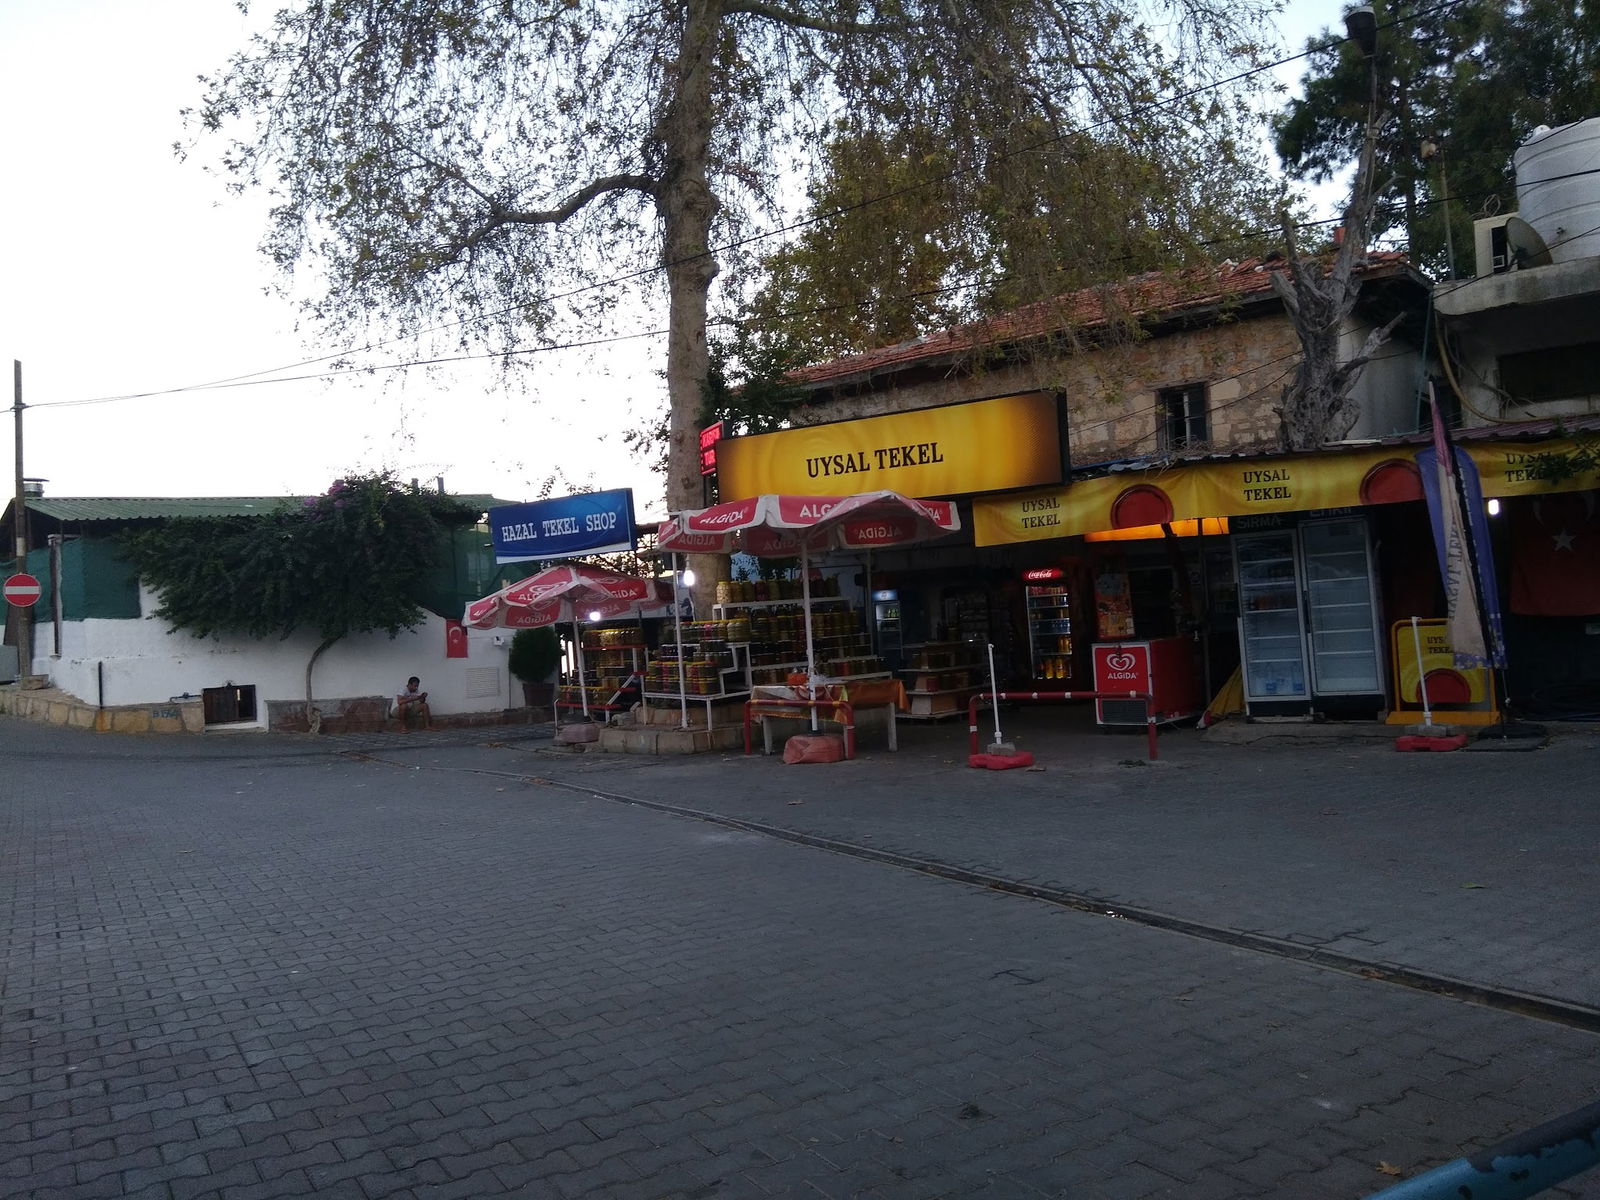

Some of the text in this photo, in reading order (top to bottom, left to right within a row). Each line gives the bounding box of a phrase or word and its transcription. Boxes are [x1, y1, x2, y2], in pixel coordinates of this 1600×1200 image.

[806, 442, 944, 479] UYSAL TEKEL
[1242, 469, 1290, 484] UYSAL
[1243, 486, 1292, 501] TEKEL
[1021, 497, 1061, 513] UYSAL
[502, 511, 617, 543] HAZAL TEKEL SHOP
[1021, 514, 1061, 529] TEKEL
